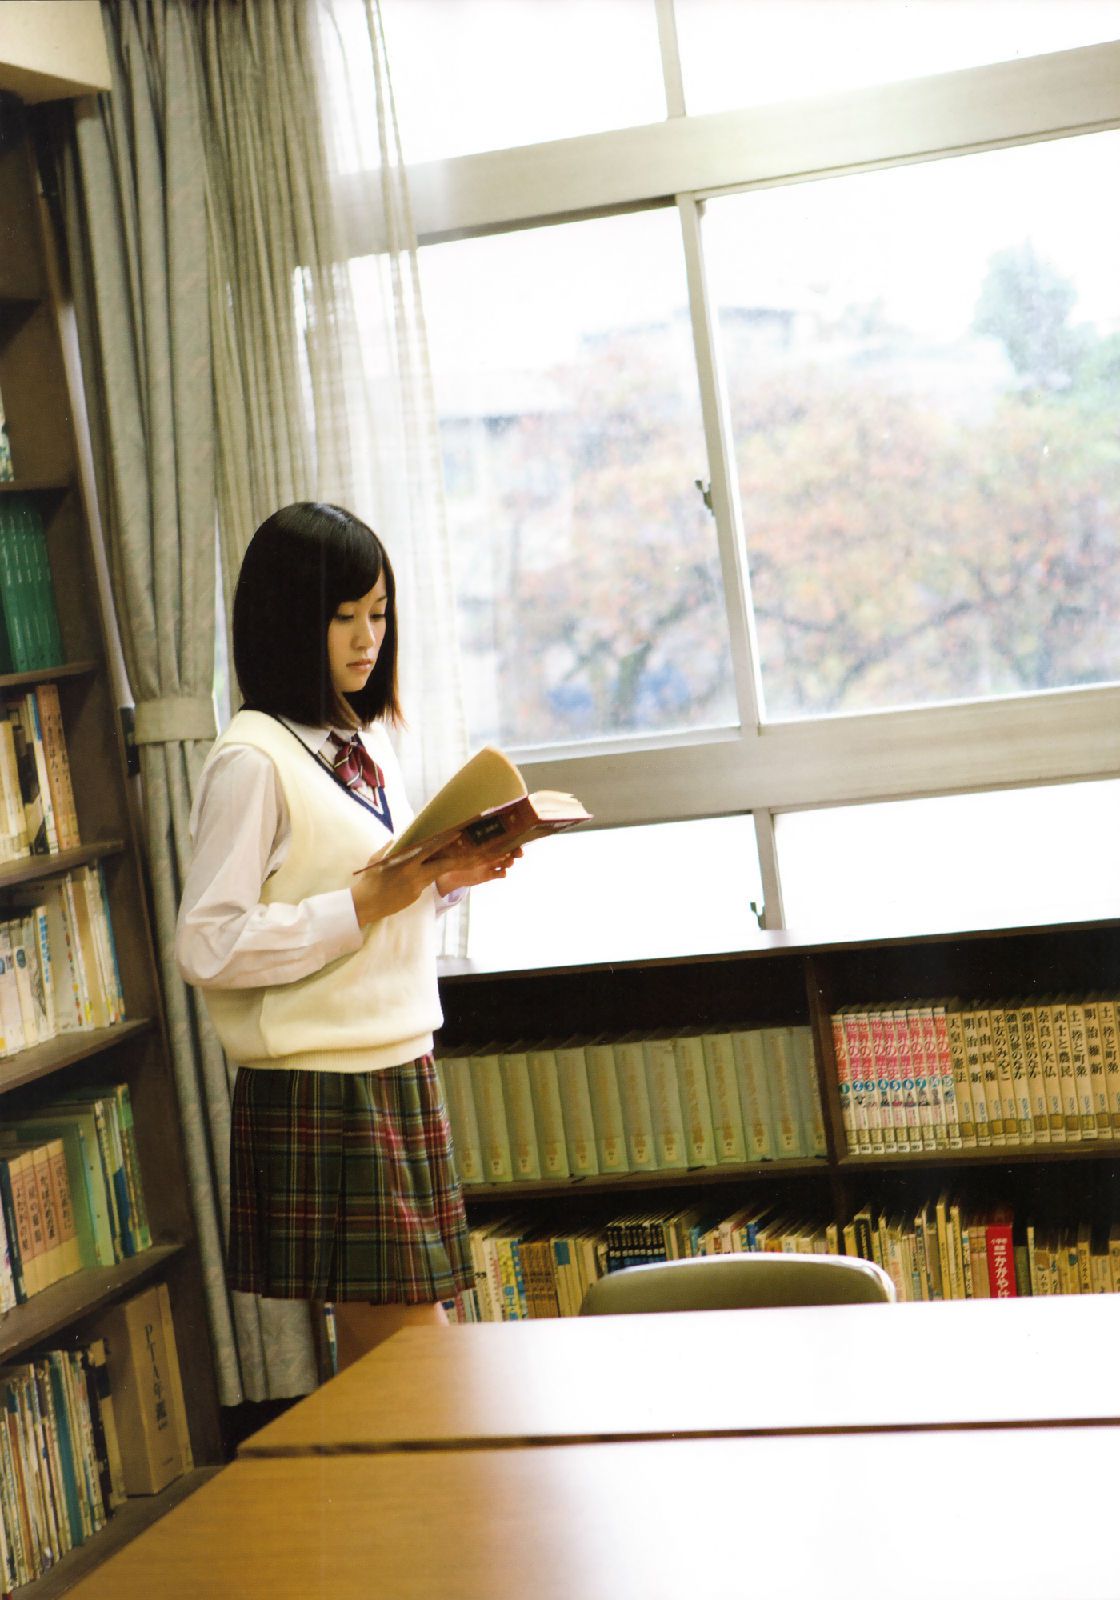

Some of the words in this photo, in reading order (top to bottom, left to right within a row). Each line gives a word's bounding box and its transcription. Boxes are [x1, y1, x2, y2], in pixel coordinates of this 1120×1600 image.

[846, 1022, 862, 1080] 世界の歴史
[858, 1022, 873, 1080] 世界の歴史
[871, 1020, 888, 1079] 世界の歴史
[882, 1021, 899, 1080] 世界の歴史
[895, 1020, 912, 1079] 世界の歴史
[909, 1018, 926, 1077] 世界の歴史
[922, 1017, 938, 1076] 世界の歴史
[935, 1016, 953, 1076] 世界の歴史
[964, 1018, 982, 1082] 明治維新
[978, 1016, 995, 1081] 自由民権
[994, 1014, 1010, 1080] 平安のみやこ
[1039, 1010, 1056, 1078] 奈良の大仏
[1054, 1010, 1073, 1078] 武士と農民
[1084, 1007, 1103, 1075] 明治維新
